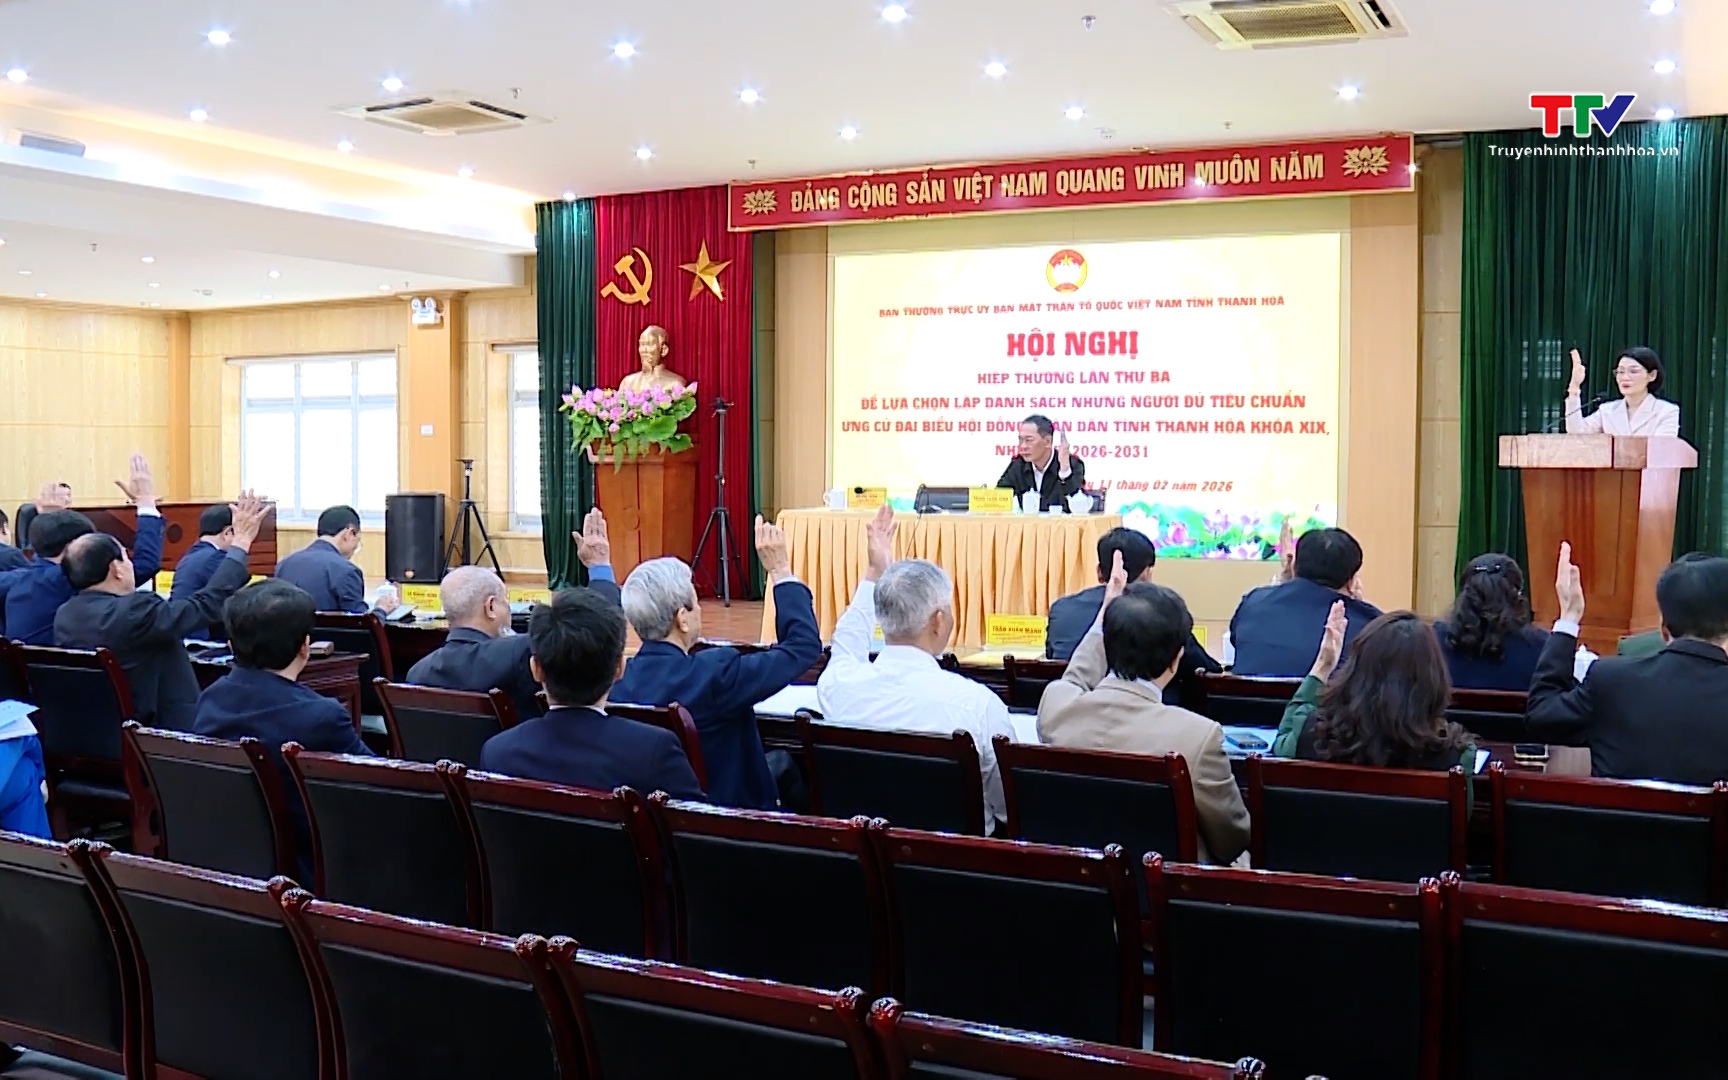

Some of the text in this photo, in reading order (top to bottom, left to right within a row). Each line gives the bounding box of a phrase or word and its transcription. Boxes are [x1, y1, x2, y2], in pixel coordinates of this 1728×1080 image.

[791, 150, 1324, 212] ĐẢNG CỘNG SẢN VIỆT NAM QUANG VINH MUÔN NĂM
[879, 308, 899, 318] BAN
[993, 304, 1015, 314] BAN
[1155, 298, 1182, 308] NAM
[1217, 296, 1257, 307] THANH
[1007, 327, 1139, 362] HỘI NGHỊ
[1150, 370, 1171, 384] BA
[912, 397, 950, 412] CHỌN
[985, 396, 1025, 409] DANH
[1155, 420, 1209, 434] THANH
[1299, 420, 1330, 436] XIX,
[1073, 445, 1148, 458] 2026-2031
[1153, 480, 1169, 490] 02
[1201, 481, 1234, 492] 2026
